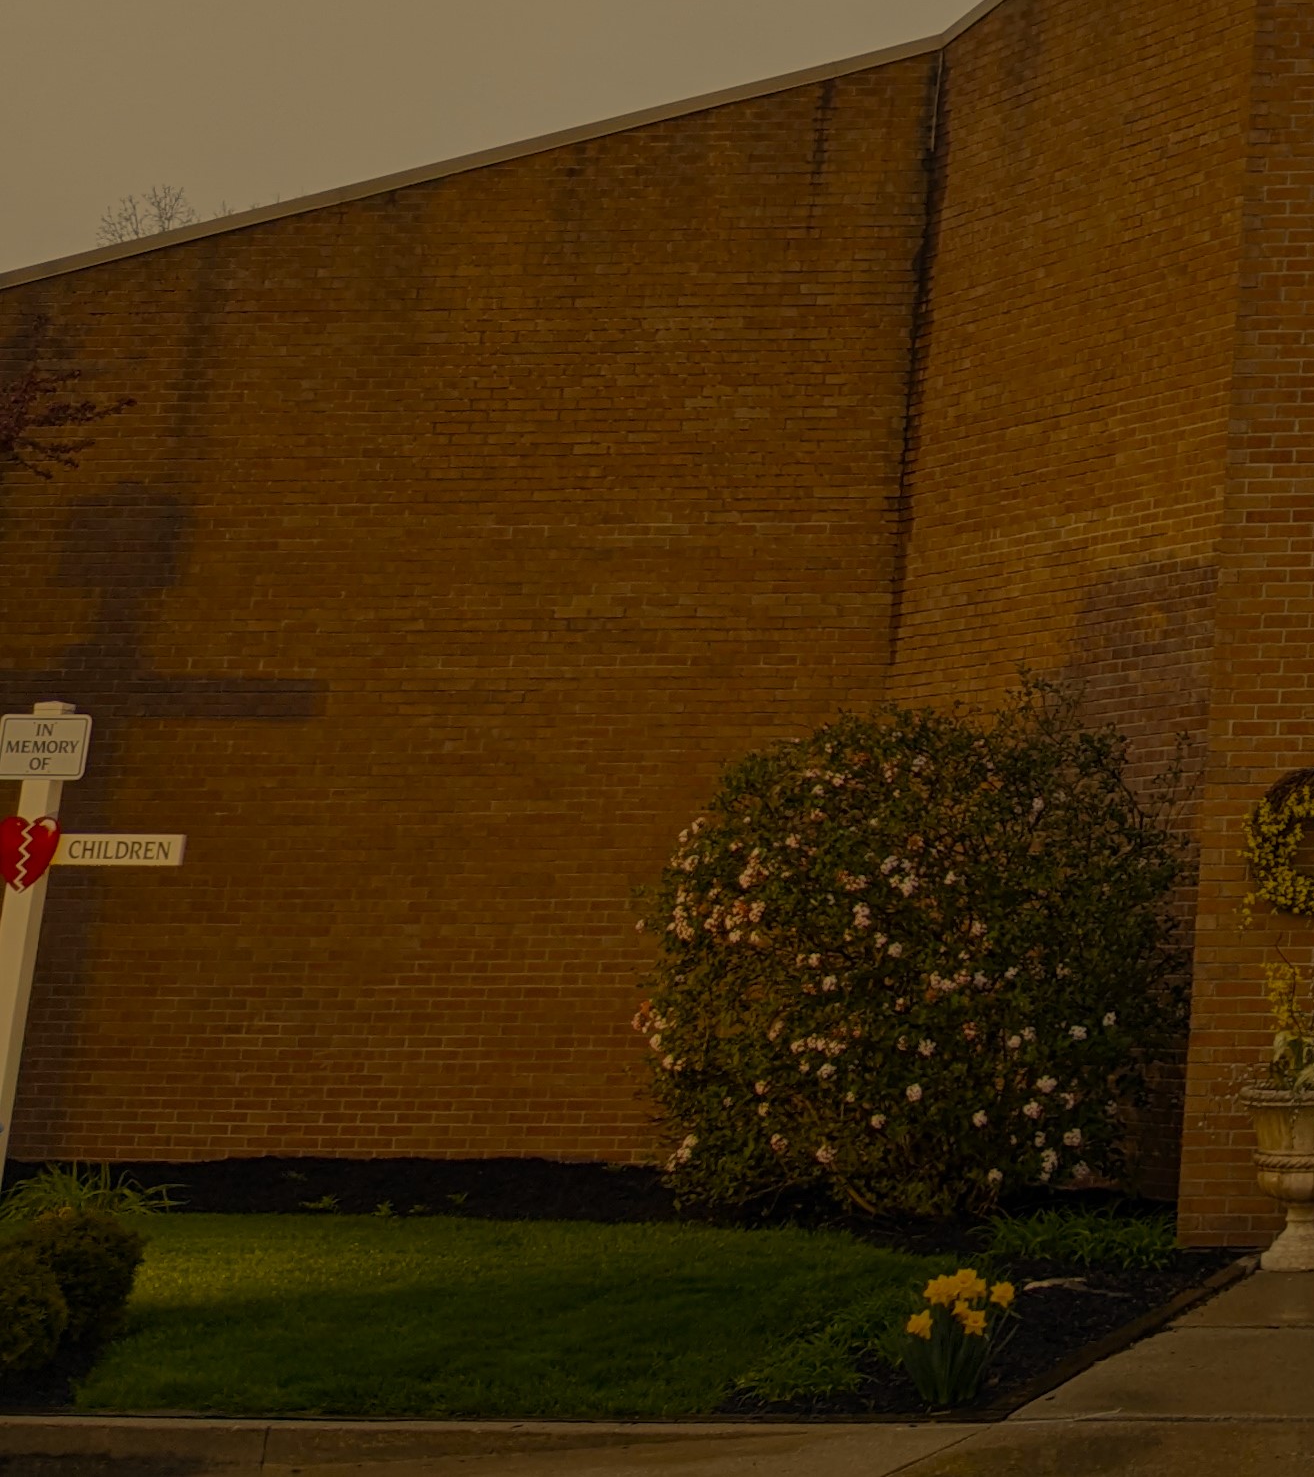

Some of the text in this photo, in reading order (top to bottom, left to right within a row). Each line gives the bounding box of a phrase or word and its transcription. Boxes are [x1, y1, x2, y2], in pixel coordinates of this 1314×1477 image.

[36, 723, 55, 737] IN
[5, 740, 79, 754] MEMORY
[29, 757, 52, 771] OF
[68, 840, 172, 860] CHILDREN
